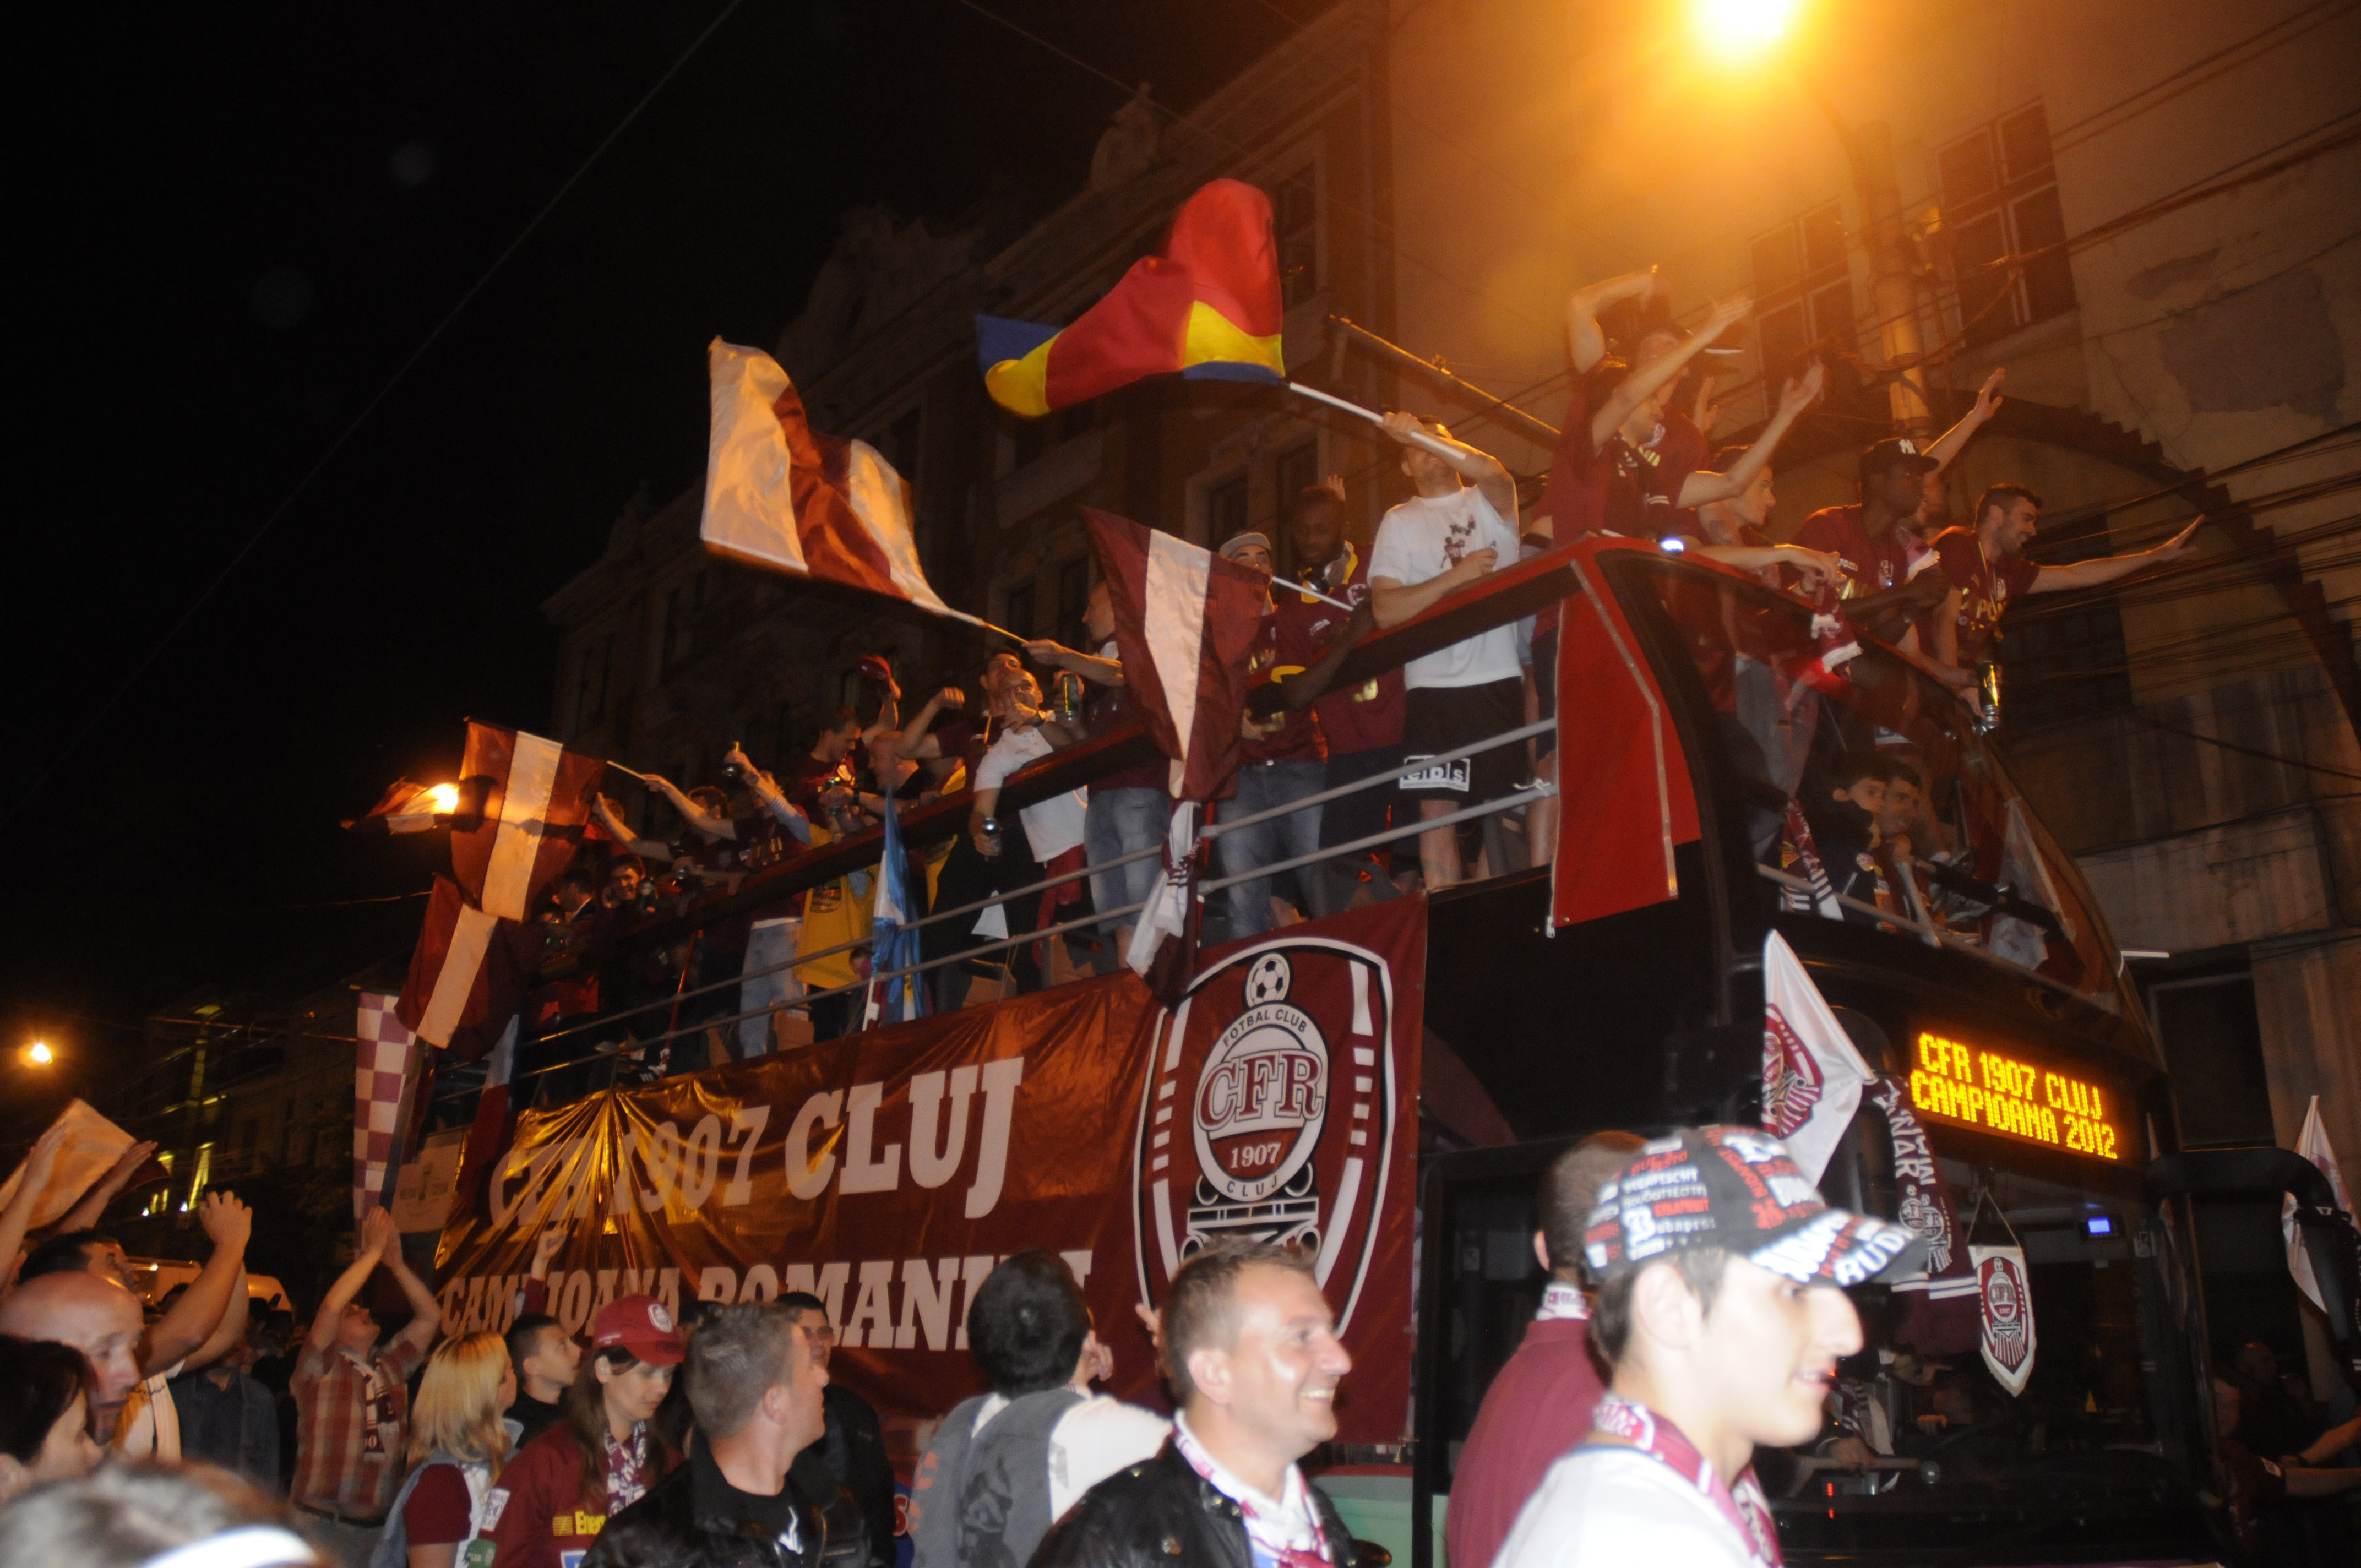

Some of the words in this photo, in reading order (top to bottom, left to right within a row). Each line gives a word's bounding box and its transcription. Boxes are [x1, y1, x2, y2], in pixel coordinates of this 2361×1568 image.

[1222, 1009, 1270, 1048] FOTBAL
[1275, 1008, 1308, 1034] CLUB
[1199, 1052, 1323, 1129] CFR
[1919, 1032, 1972, 1084] CFR
[1979, 1051, 2036, 1101] 1907
[2045, 1071, 2103, 1120] CLUJ
[608, 1106, 770, 1216] 1907
[785, 1057, 1025, 1219] CLUJ
[1910, 1068, 2059, 1144] CAMPIOANA
[2063, 1113, 2118, 1159] 2012
[1226, 1174, 1278, 1197] CLUJ
[1230, 1142, 1282, 1169] 1907
[441, 1268, 680, 1337] CAMIOAA
